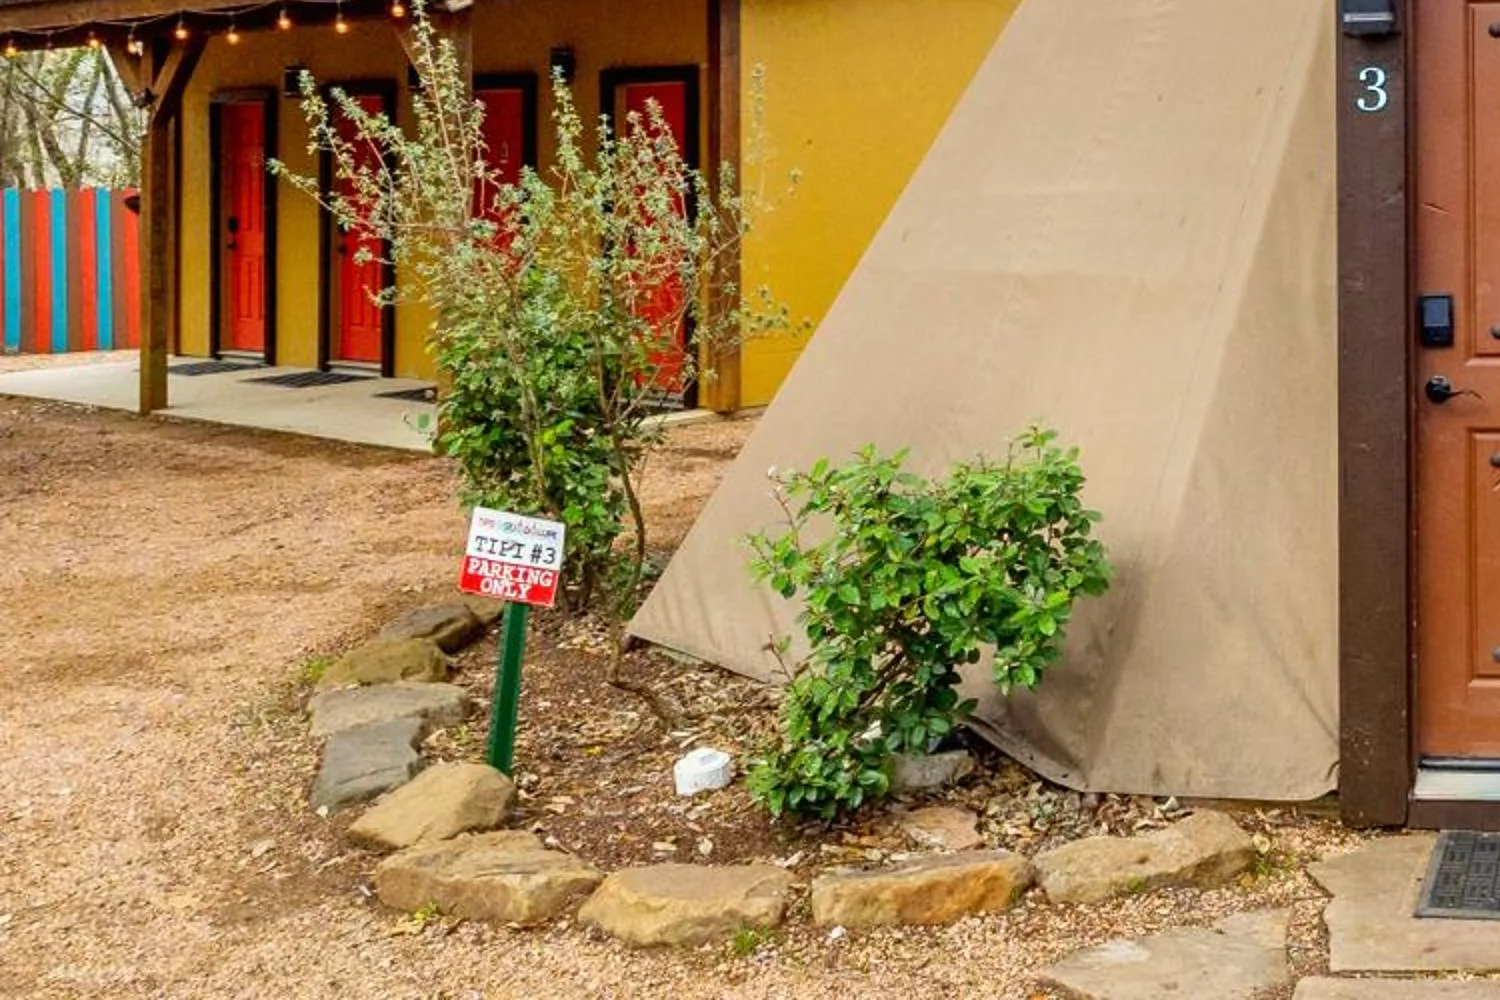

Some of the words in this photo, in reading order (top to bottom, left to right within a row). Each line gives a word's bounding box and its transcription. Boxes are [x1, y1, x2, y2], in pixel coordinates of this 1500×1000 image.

[1357, 67, 1387, 111] 3
[475, 535, 525, 559] TIPI
[530, 543, 557, 565] #3
[467, 557, 553, 587] PARKING
[480, 577, 532, 599] ONLY
